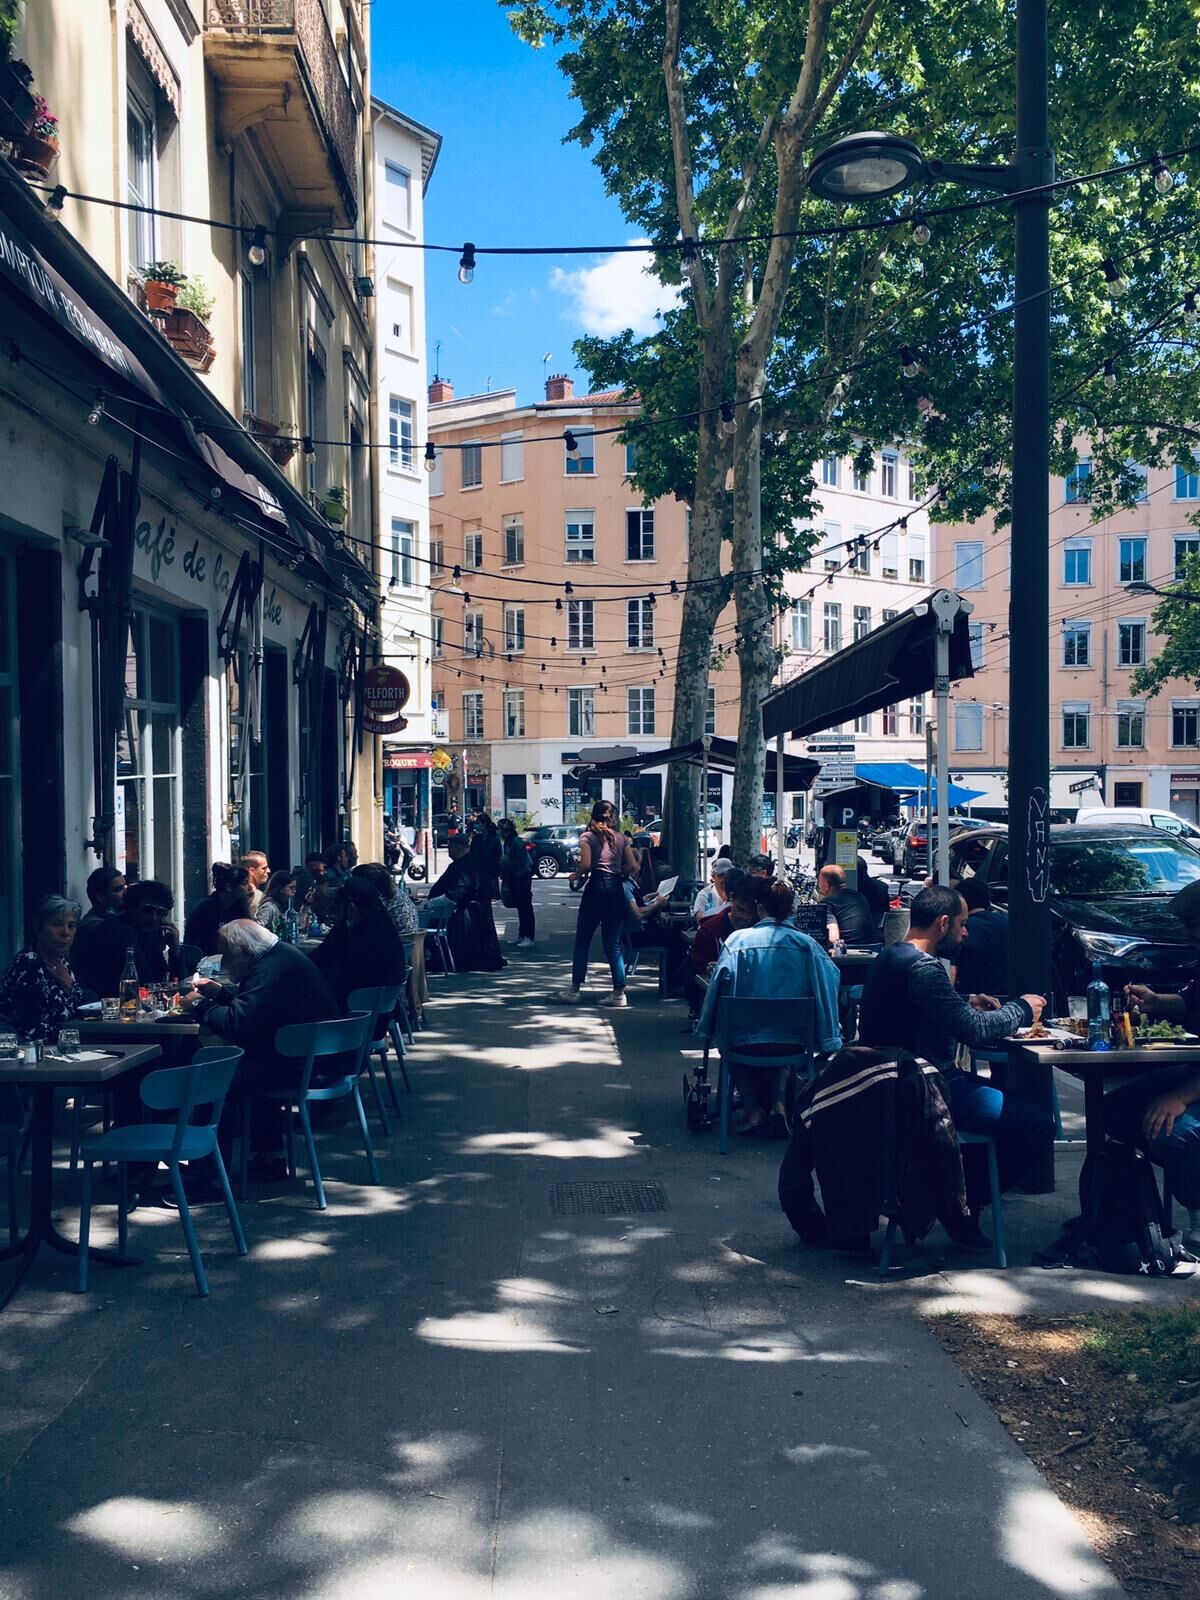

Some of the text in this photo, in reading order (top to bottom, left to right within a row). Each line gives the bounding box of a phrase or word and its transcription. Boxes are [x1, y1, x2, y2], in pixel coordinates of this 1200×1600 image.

[60, 290, 132, 374] RESTAURANT
[135, 508, 176, 581] afé
[183, 538, 206, 582] de
[842, 807, 855, 826] P
